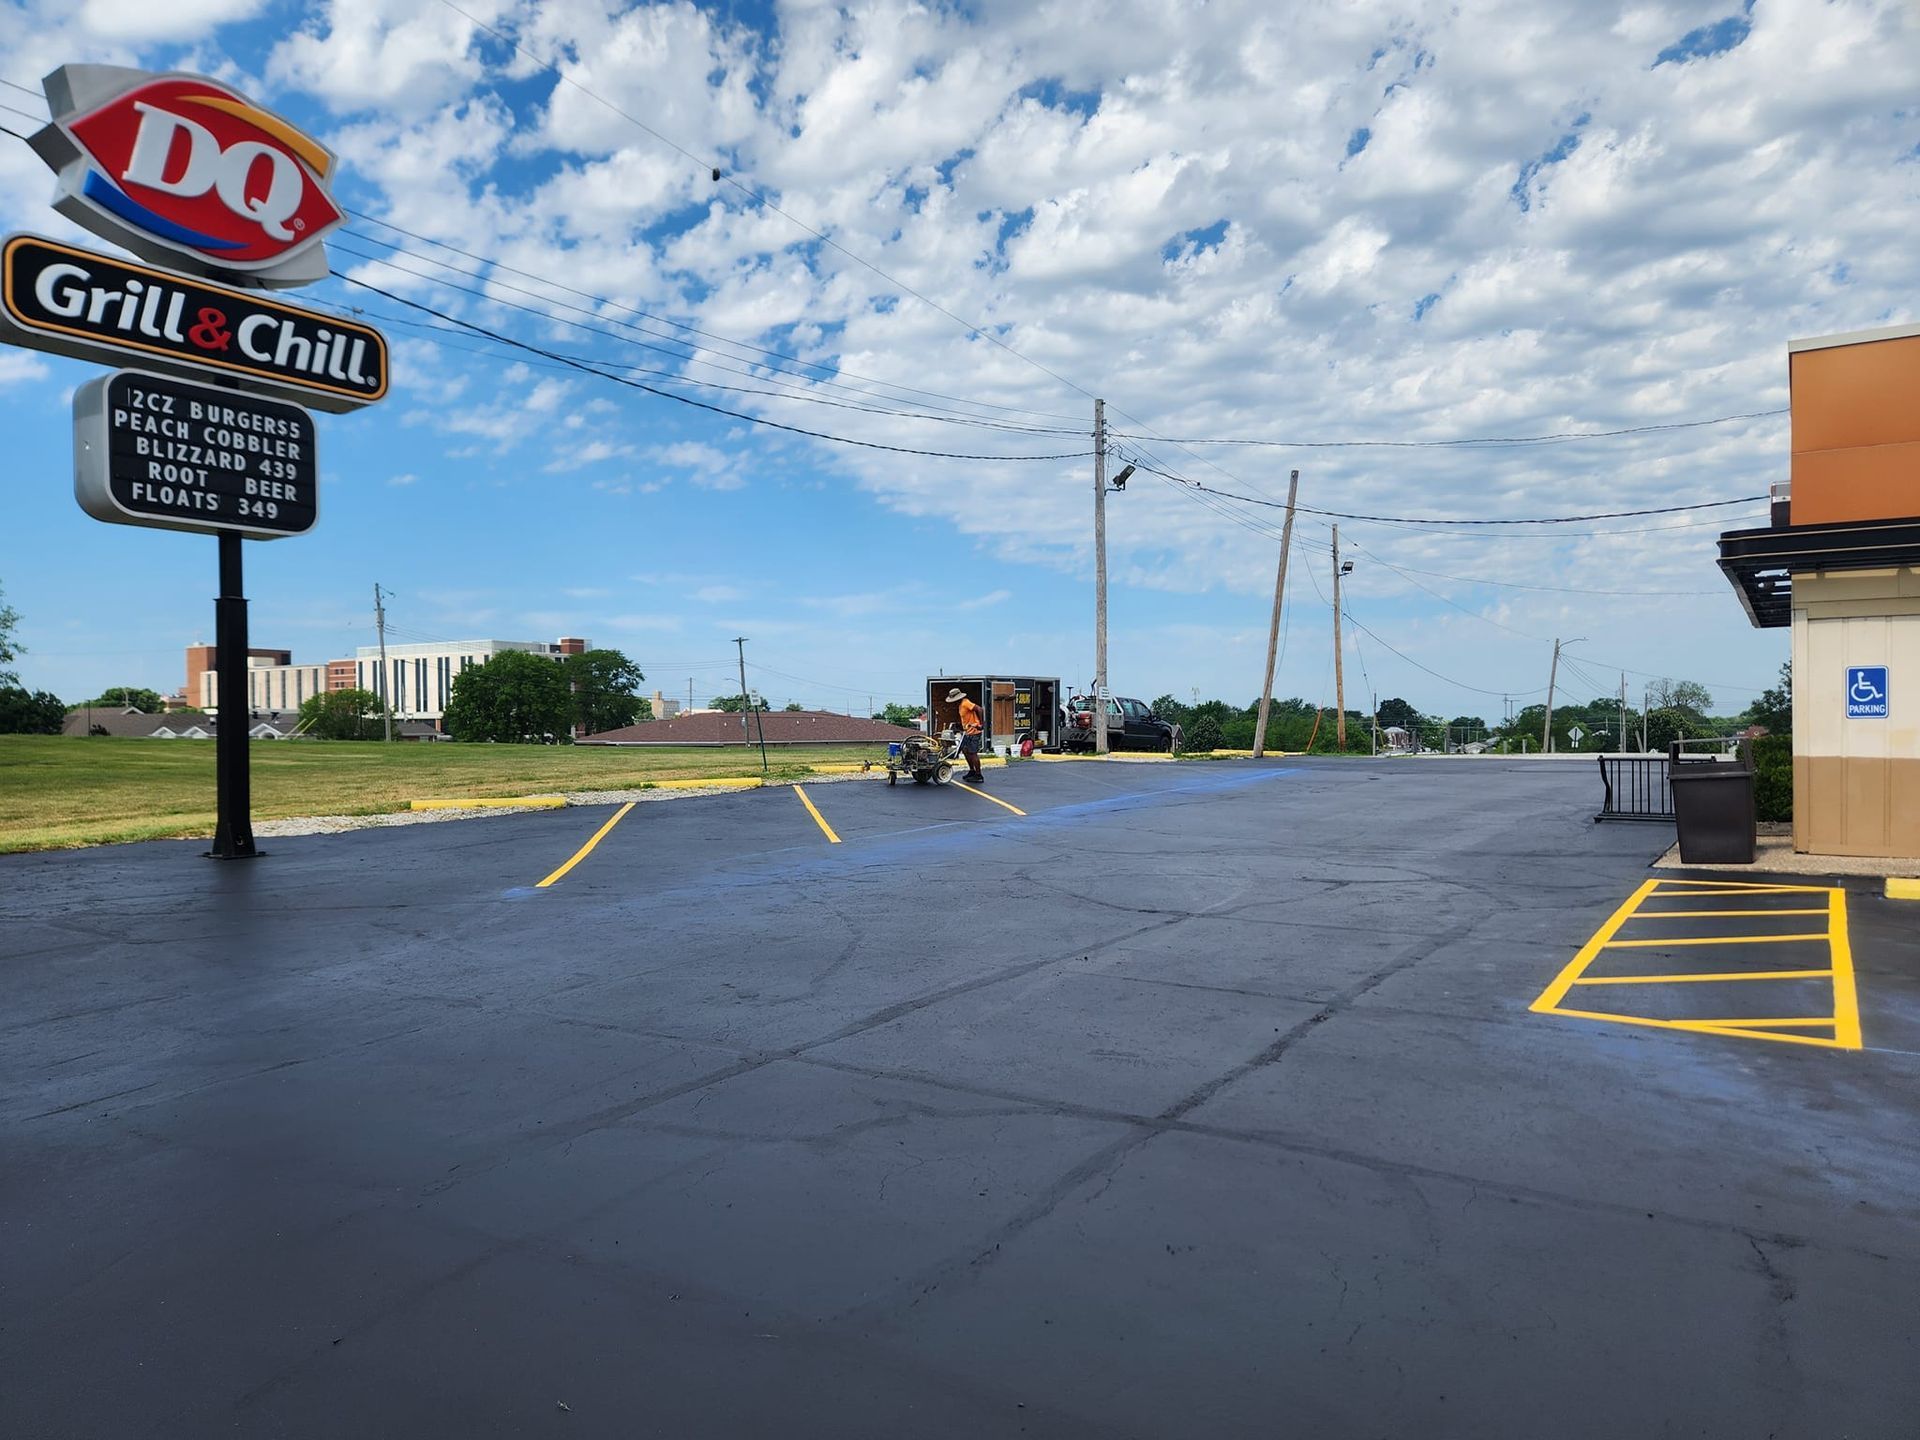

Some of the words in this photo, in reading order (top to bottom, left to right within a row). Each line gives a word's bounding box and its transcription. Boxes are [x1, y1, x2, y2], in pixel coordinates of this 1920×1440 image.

[121, 101, 304, 241] DQ
[35, 263, 184, 343] Grill
[188, 307, 232, 350] &
[237, 314, 367, 386] Chill
[114, 408, 189, 440] PEACH
[203, 427, 300, 460] COBBLER
[136, 436, 246, 471] BLIZZARD
[259, 459, 297, 480] 439
[132, 482, 219, 511] FLOATS
[238, 498, 279, 519] 349
[148, 461, 209, 487] ROOT
[245, 477, 297, 501] BEER
[1849, 704, 1886, 714] PARKING
